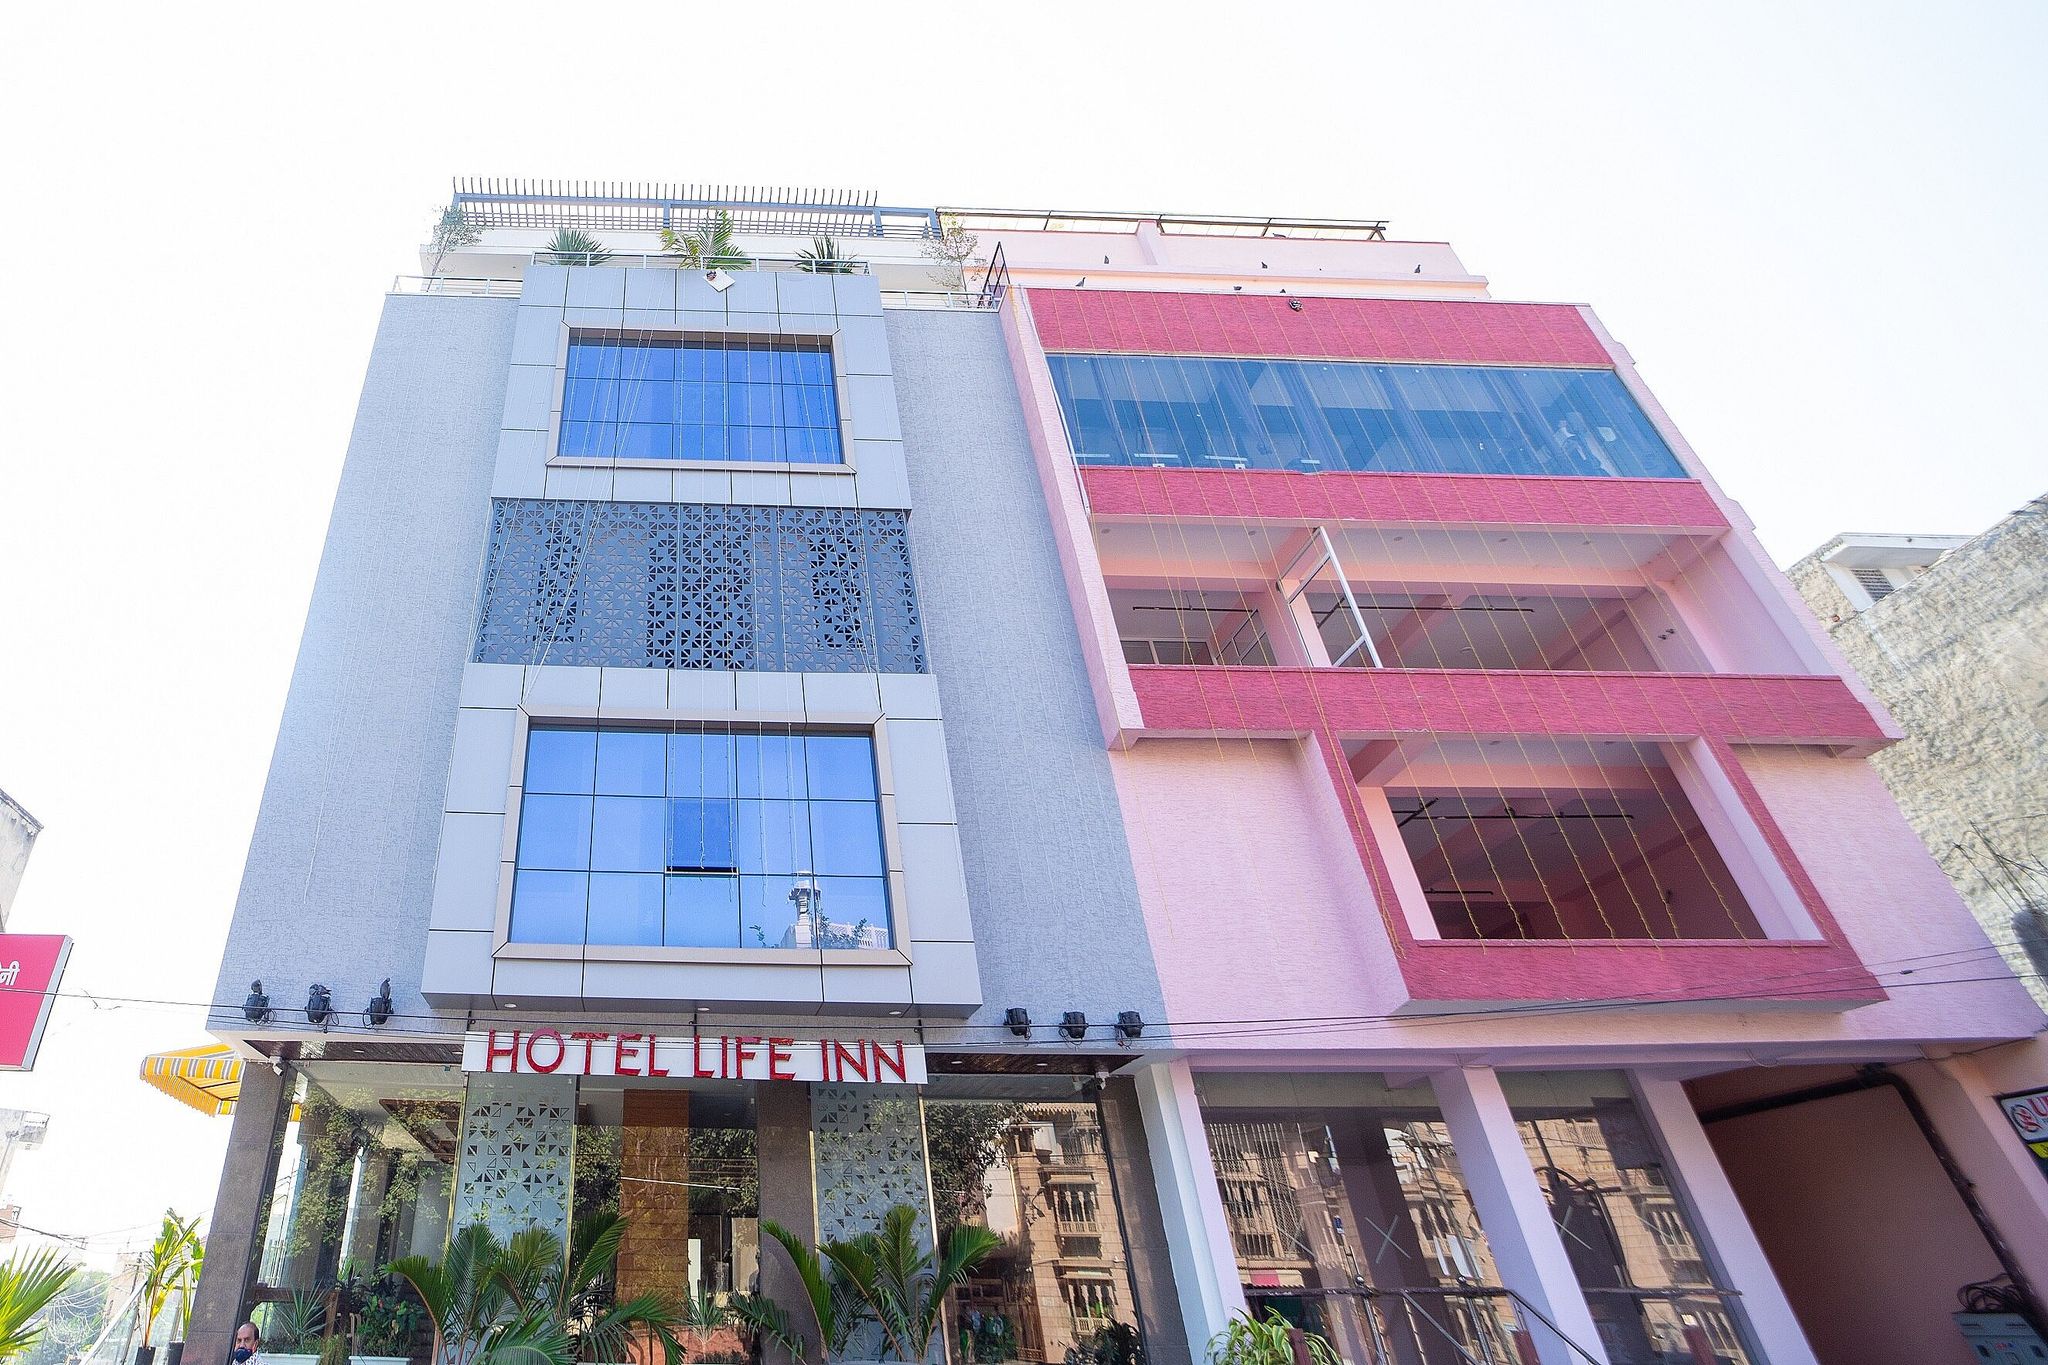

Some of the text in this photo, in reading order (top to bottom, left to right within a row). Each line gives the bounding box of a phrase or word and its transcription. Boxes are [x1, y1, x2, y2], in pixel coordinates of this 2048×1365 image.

[0, 960, 20, 986] नी
[486, 1027, 906, 1082] HOTEL LIFE INN
